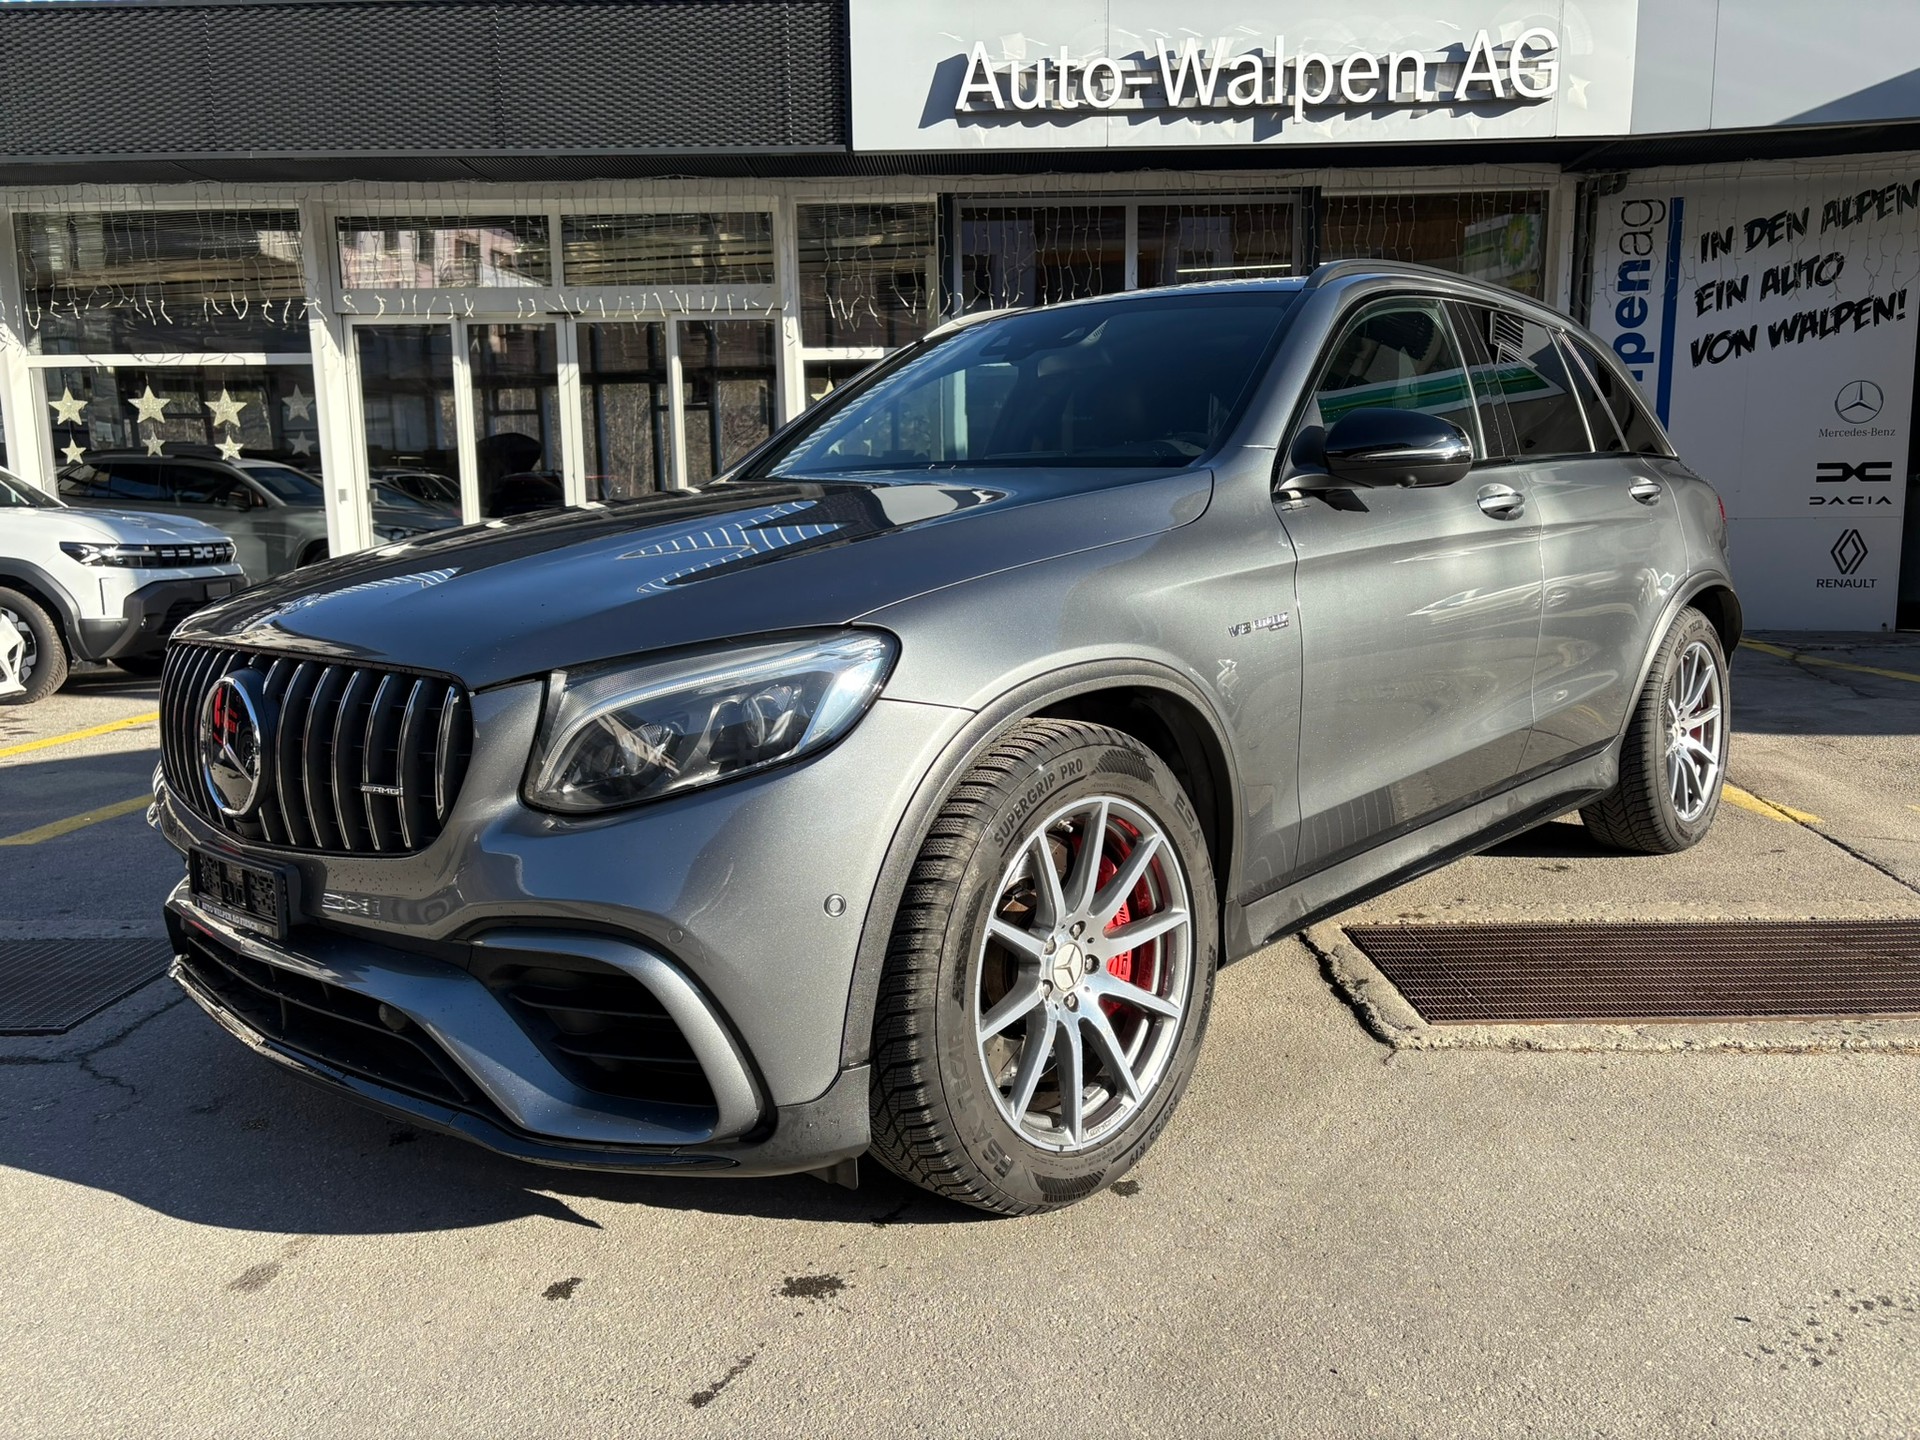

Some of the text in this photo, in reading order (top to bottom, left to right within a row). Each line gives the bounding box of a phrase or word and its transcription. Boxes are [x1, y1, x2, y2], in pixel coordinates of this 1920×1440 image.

[956, 26, 1559, 124] Auto-Walpen AG
[1700, 179, 1920, 263] IN DEN ALPEN
[1694, 252, 1845, 318] EIN AUTO
[1690, 288, 1907, 368] VON WALPEN!
[1818, 427, 1896, 438] Mercedes-Benz
[1809, 496, 1893, 505] DACIA
[1816, 578, 1878, 588] RENAULT
[993, 758, 1083, 849] SUPERGRIP PRO
